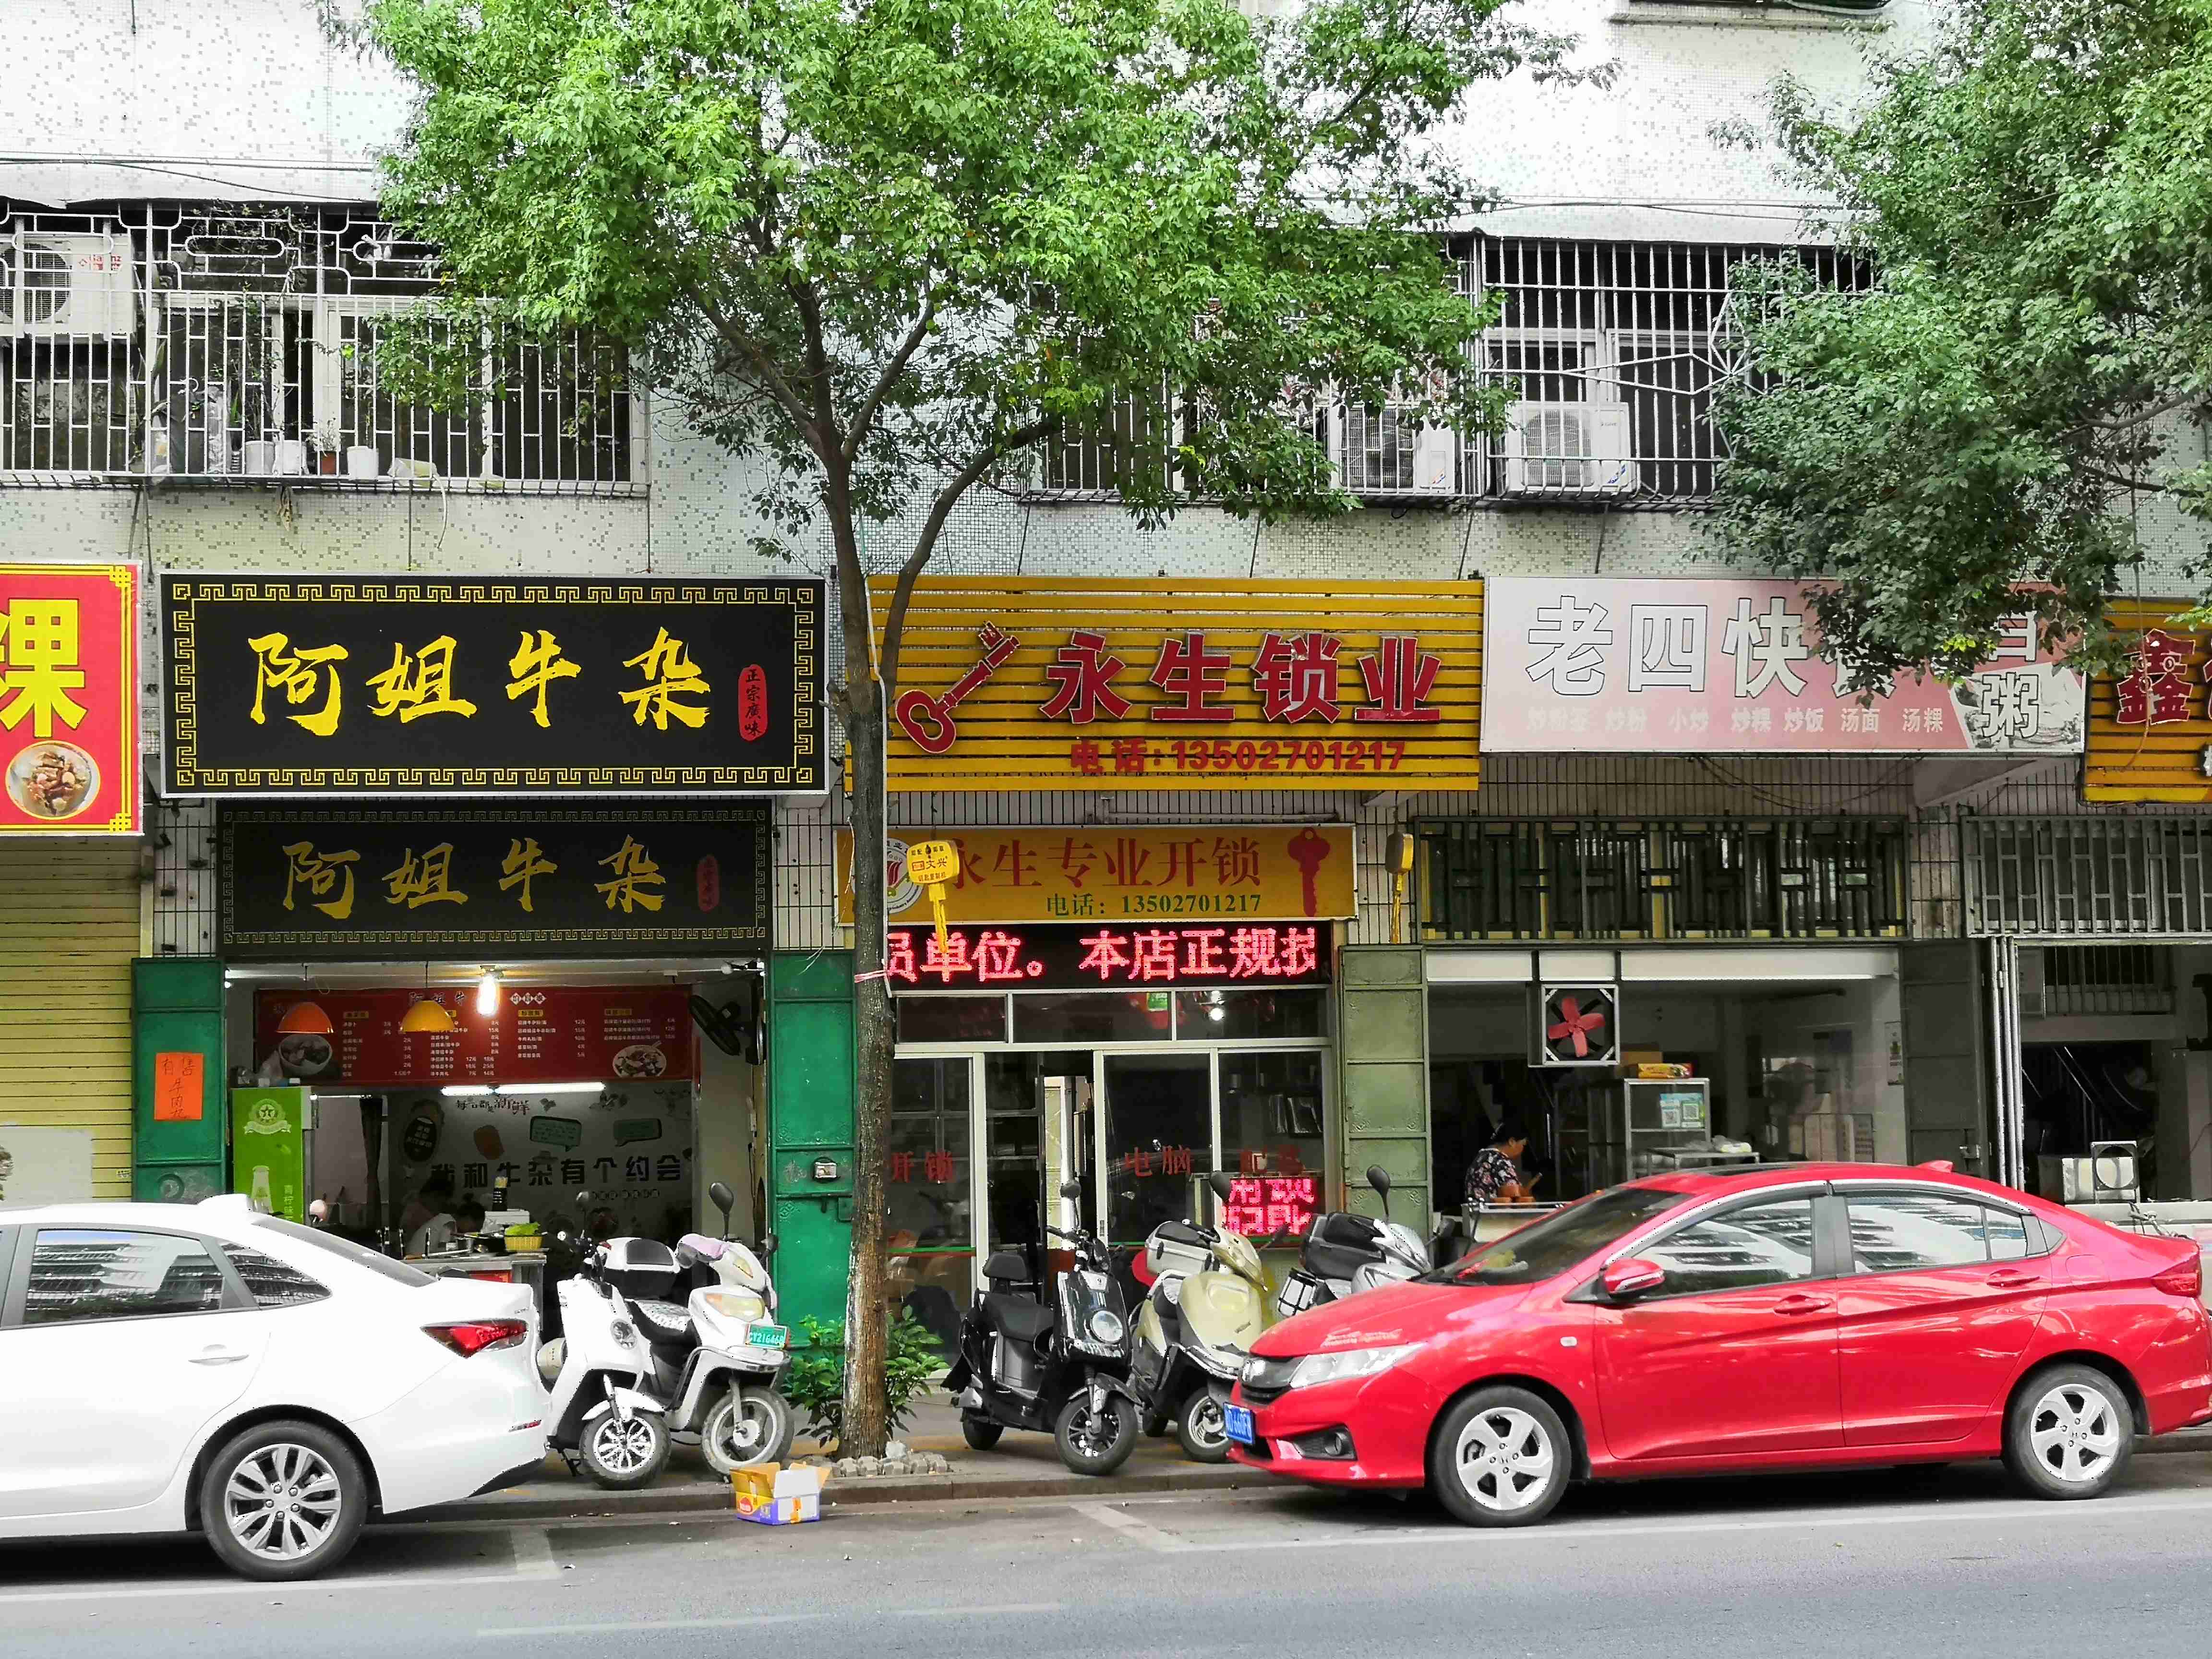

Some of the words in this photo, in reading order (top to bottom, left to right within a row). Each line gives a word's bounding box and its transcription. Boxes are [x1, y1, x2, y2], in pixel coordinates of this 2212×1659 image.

[248, 627, 710, 736] 阿姐牛杂
[1040, 631, 1442, 724] 永生锁业
[1668, 707, 1709, 733] 小炒
[1784, 707, 1824, 733] 炒饭
[1840, 708, 1881, 733] 汤面
[282, 834, 666, 922] 阿姐牛杂
[1121, 895, 1261, 913] 13502701217
[1124, 1145, 1191, 1177] 电脑
